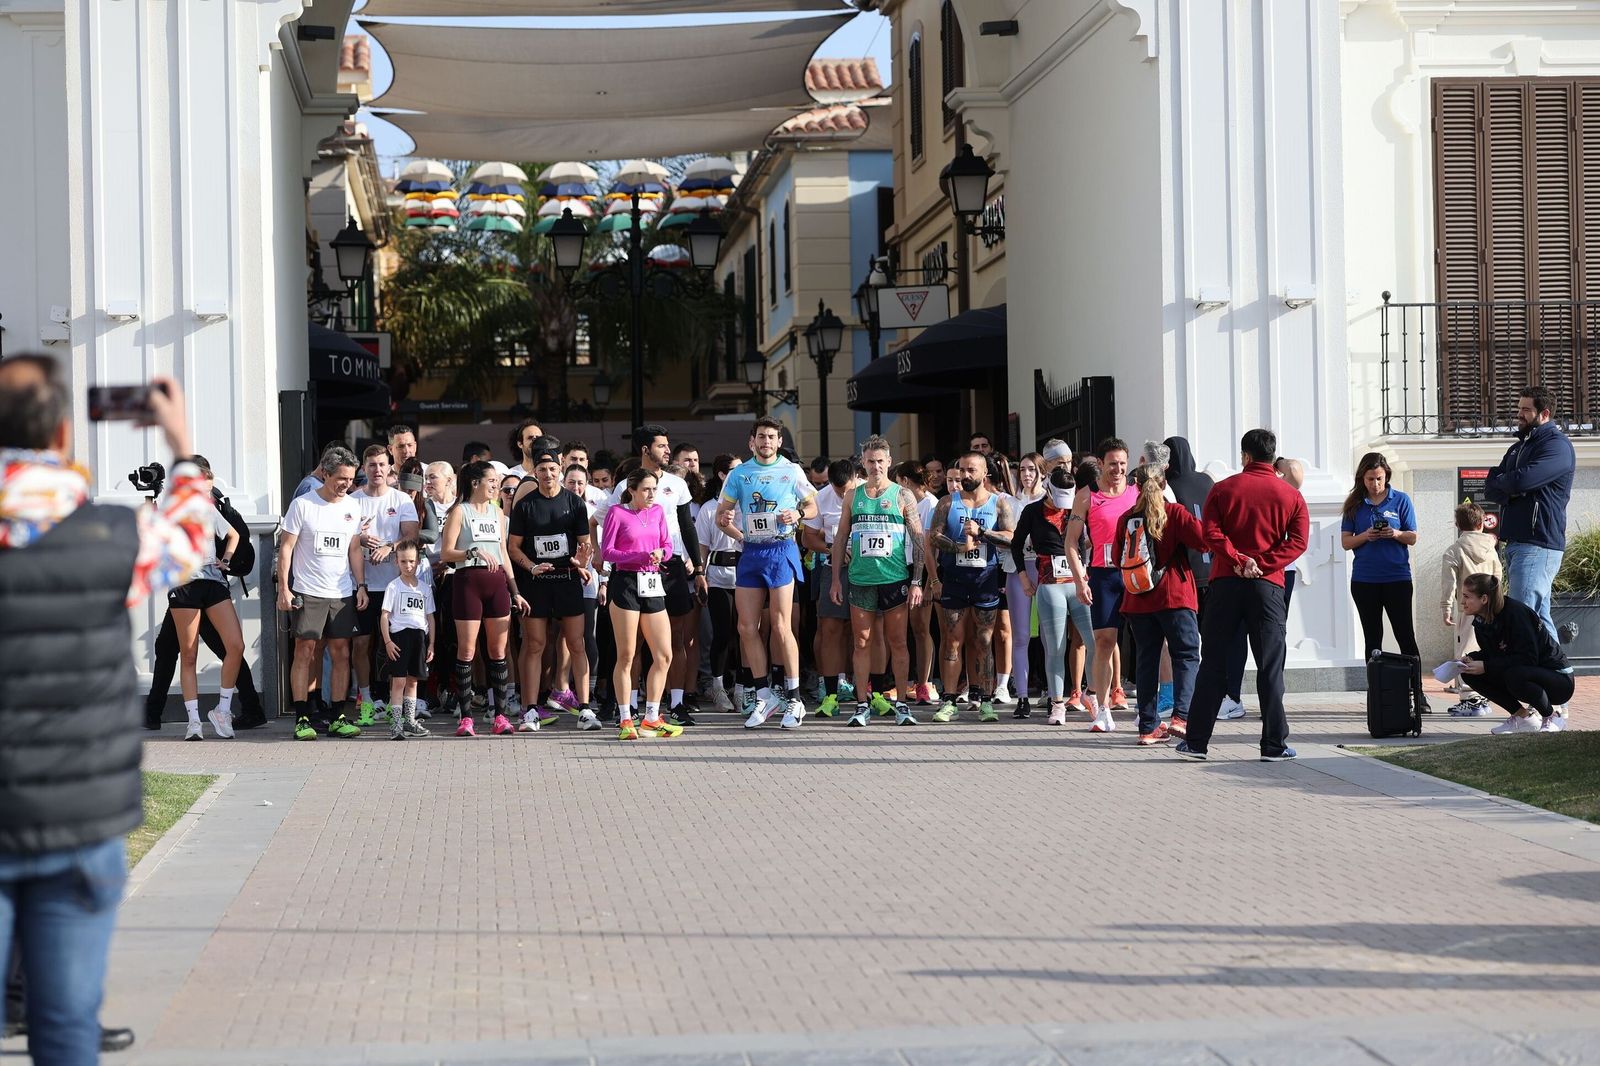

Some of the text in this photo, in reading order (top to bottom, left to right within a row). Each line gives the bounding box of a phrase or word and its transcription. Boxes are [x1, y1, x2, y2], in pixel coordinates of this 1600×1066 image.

[419, 402, 439, 410] Guest
[858, 514, 889, 522] ATLETISMO
[479, 523, 496, 534] 408
[753, 518, 768, 530] 161
[323, 537, 340, 549] 501
[542, 540, 560, 552] 108
[868, 537, 885, 549] 179
[964, 549, 980, 560] 169
[648, 578, 656, 589] 84
[407, 597, 424, 610] 503
